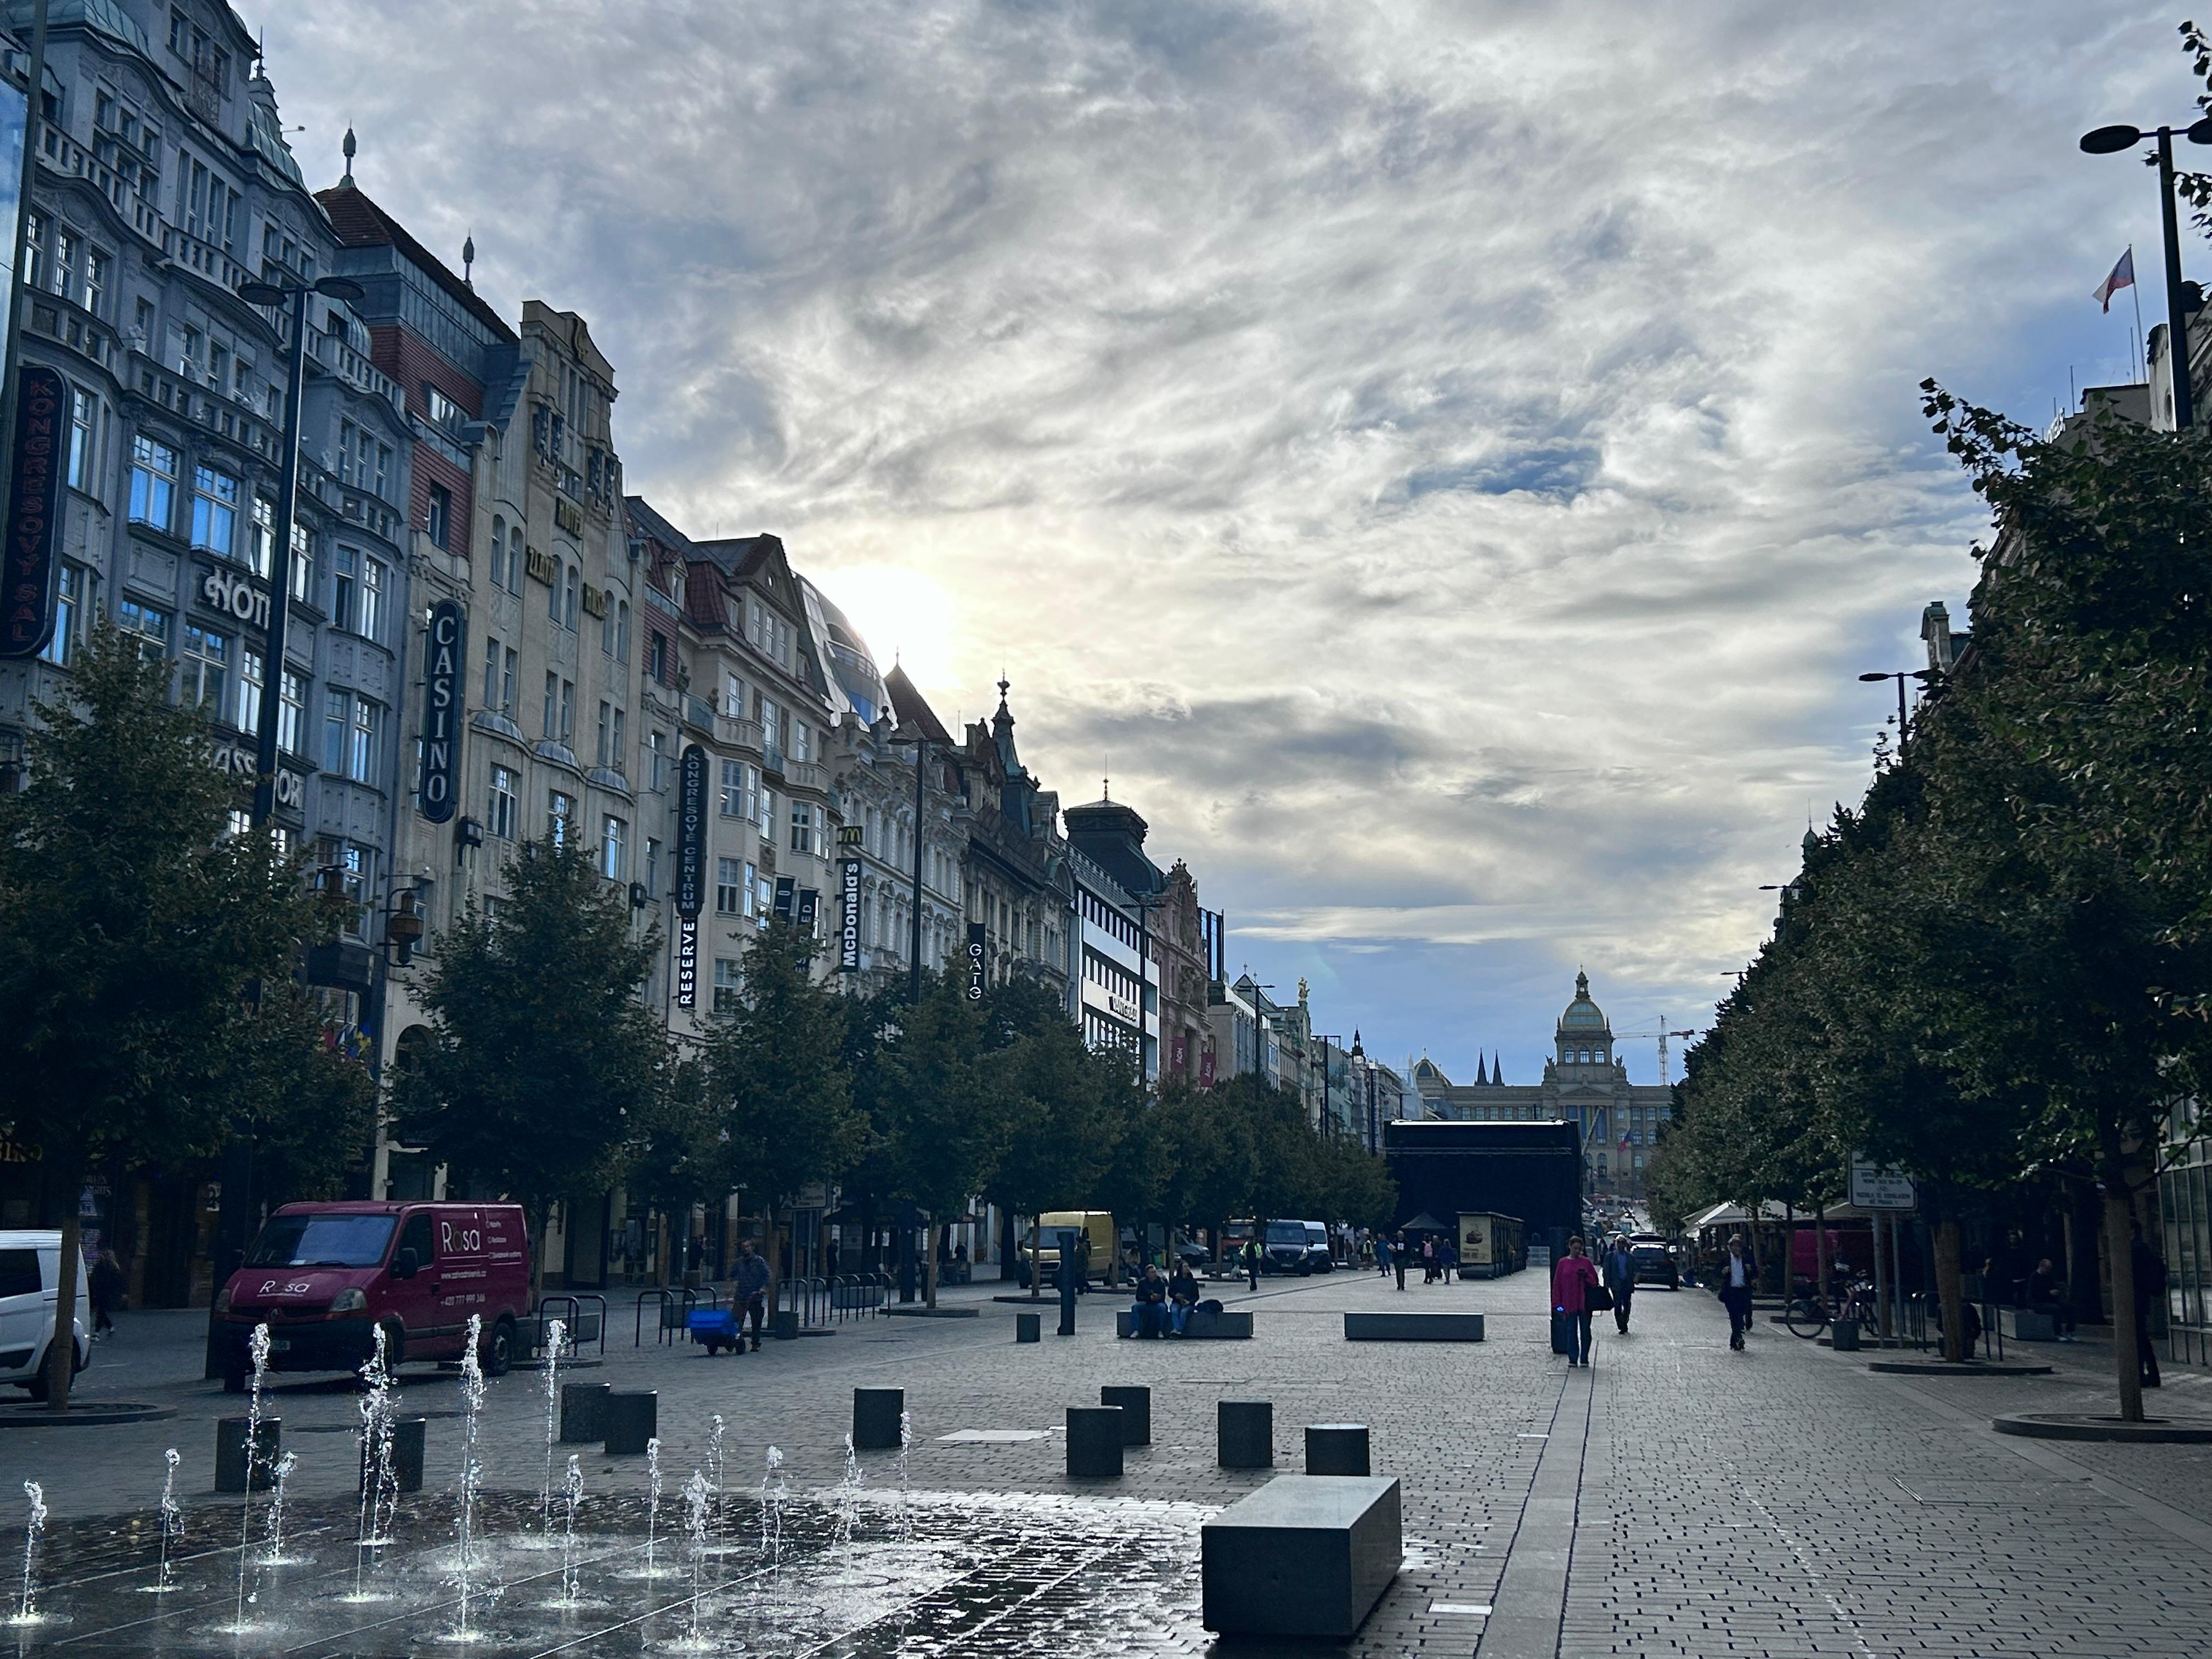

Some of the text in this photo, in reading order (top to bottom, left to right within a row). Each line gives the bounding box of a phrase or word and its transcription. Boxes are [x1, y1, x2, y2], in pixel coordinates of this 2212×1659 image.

[204, 565, 271, 631] HOT
[427, 616, 455, 802] CASINO
[681, 847, 697, 910] CENTRUM
[843, 862, 859, 966] McDonald's
[680, 917, 696, 1005] RESERVE
[259, 1280, 311, 1293] Rsa
